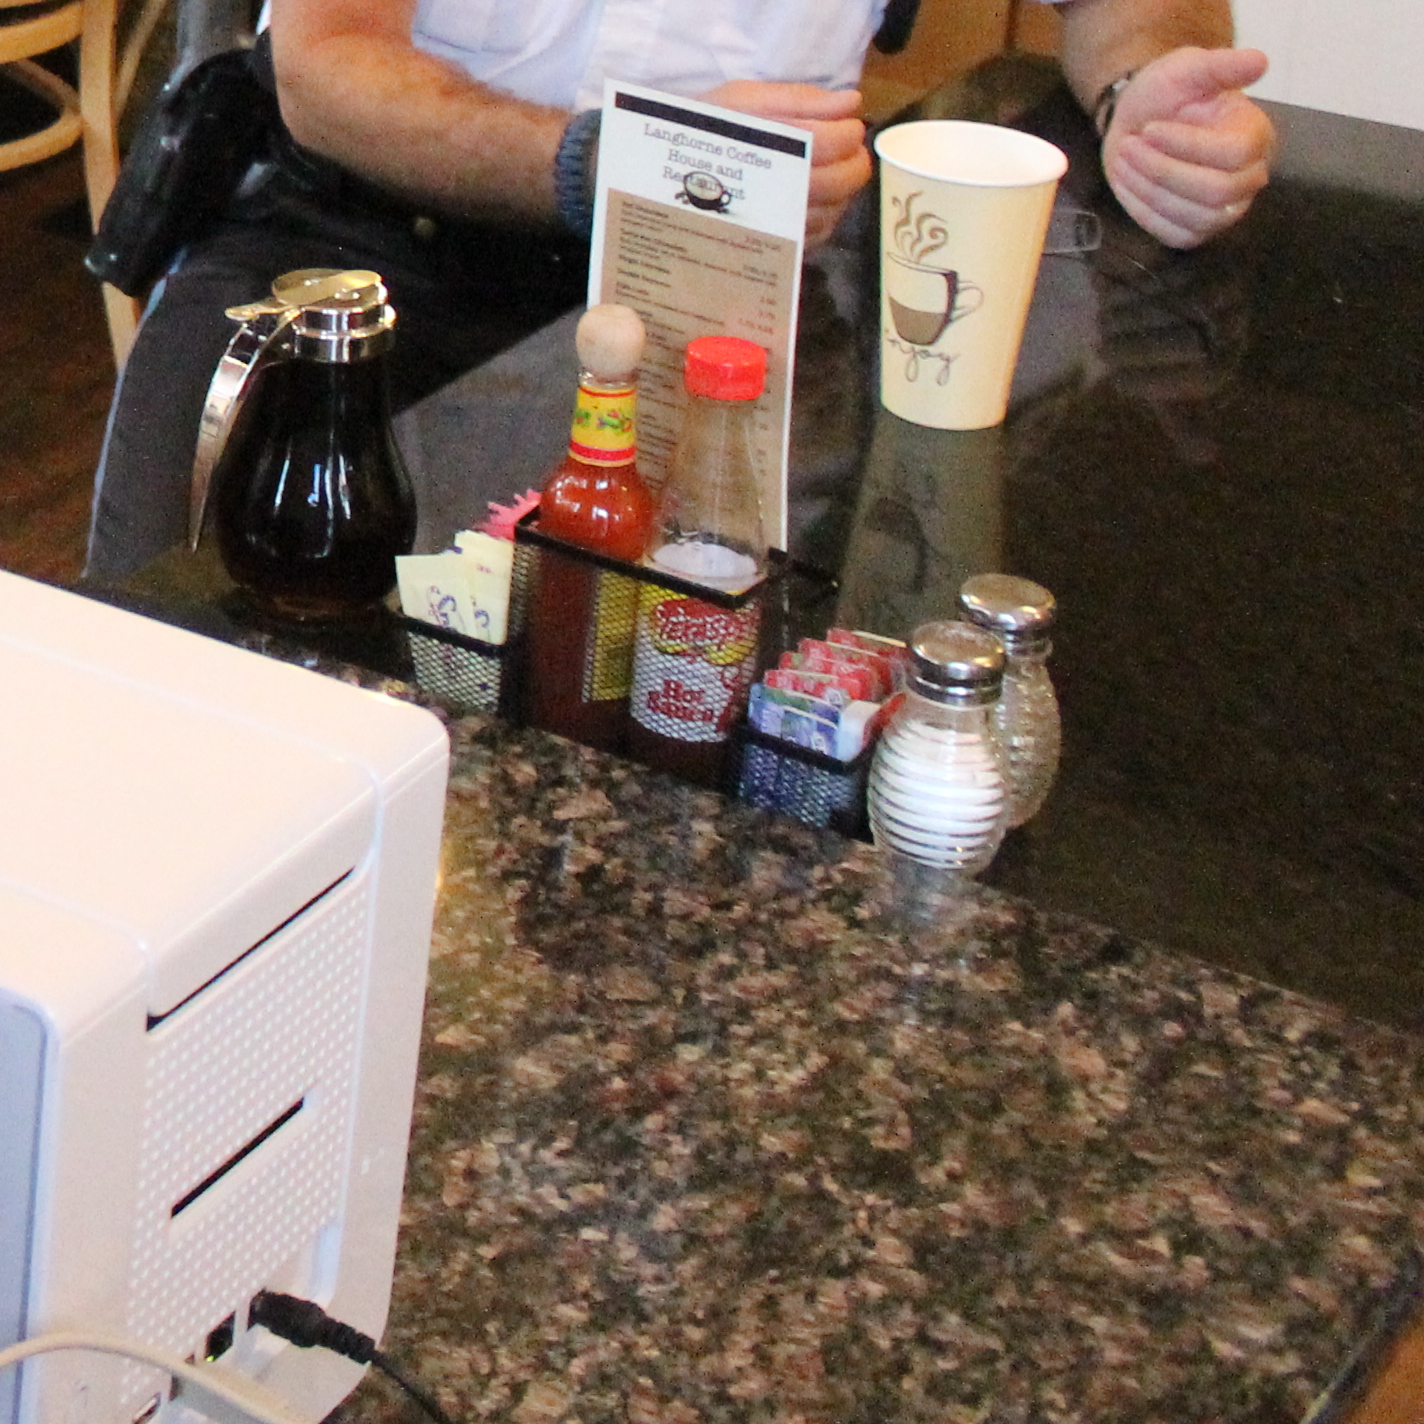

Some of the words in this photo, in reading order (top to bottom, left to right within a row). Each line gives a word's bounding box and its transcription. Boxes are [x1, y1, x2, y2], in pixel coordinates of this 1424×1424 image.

[643, 122, 723, 156] Langhorne
[726, 146, 773, 170] Coffee
[667, 149, 713, 173] House
[716, 162, 744, 182] and
[663, 678, 705, 704] Hot
